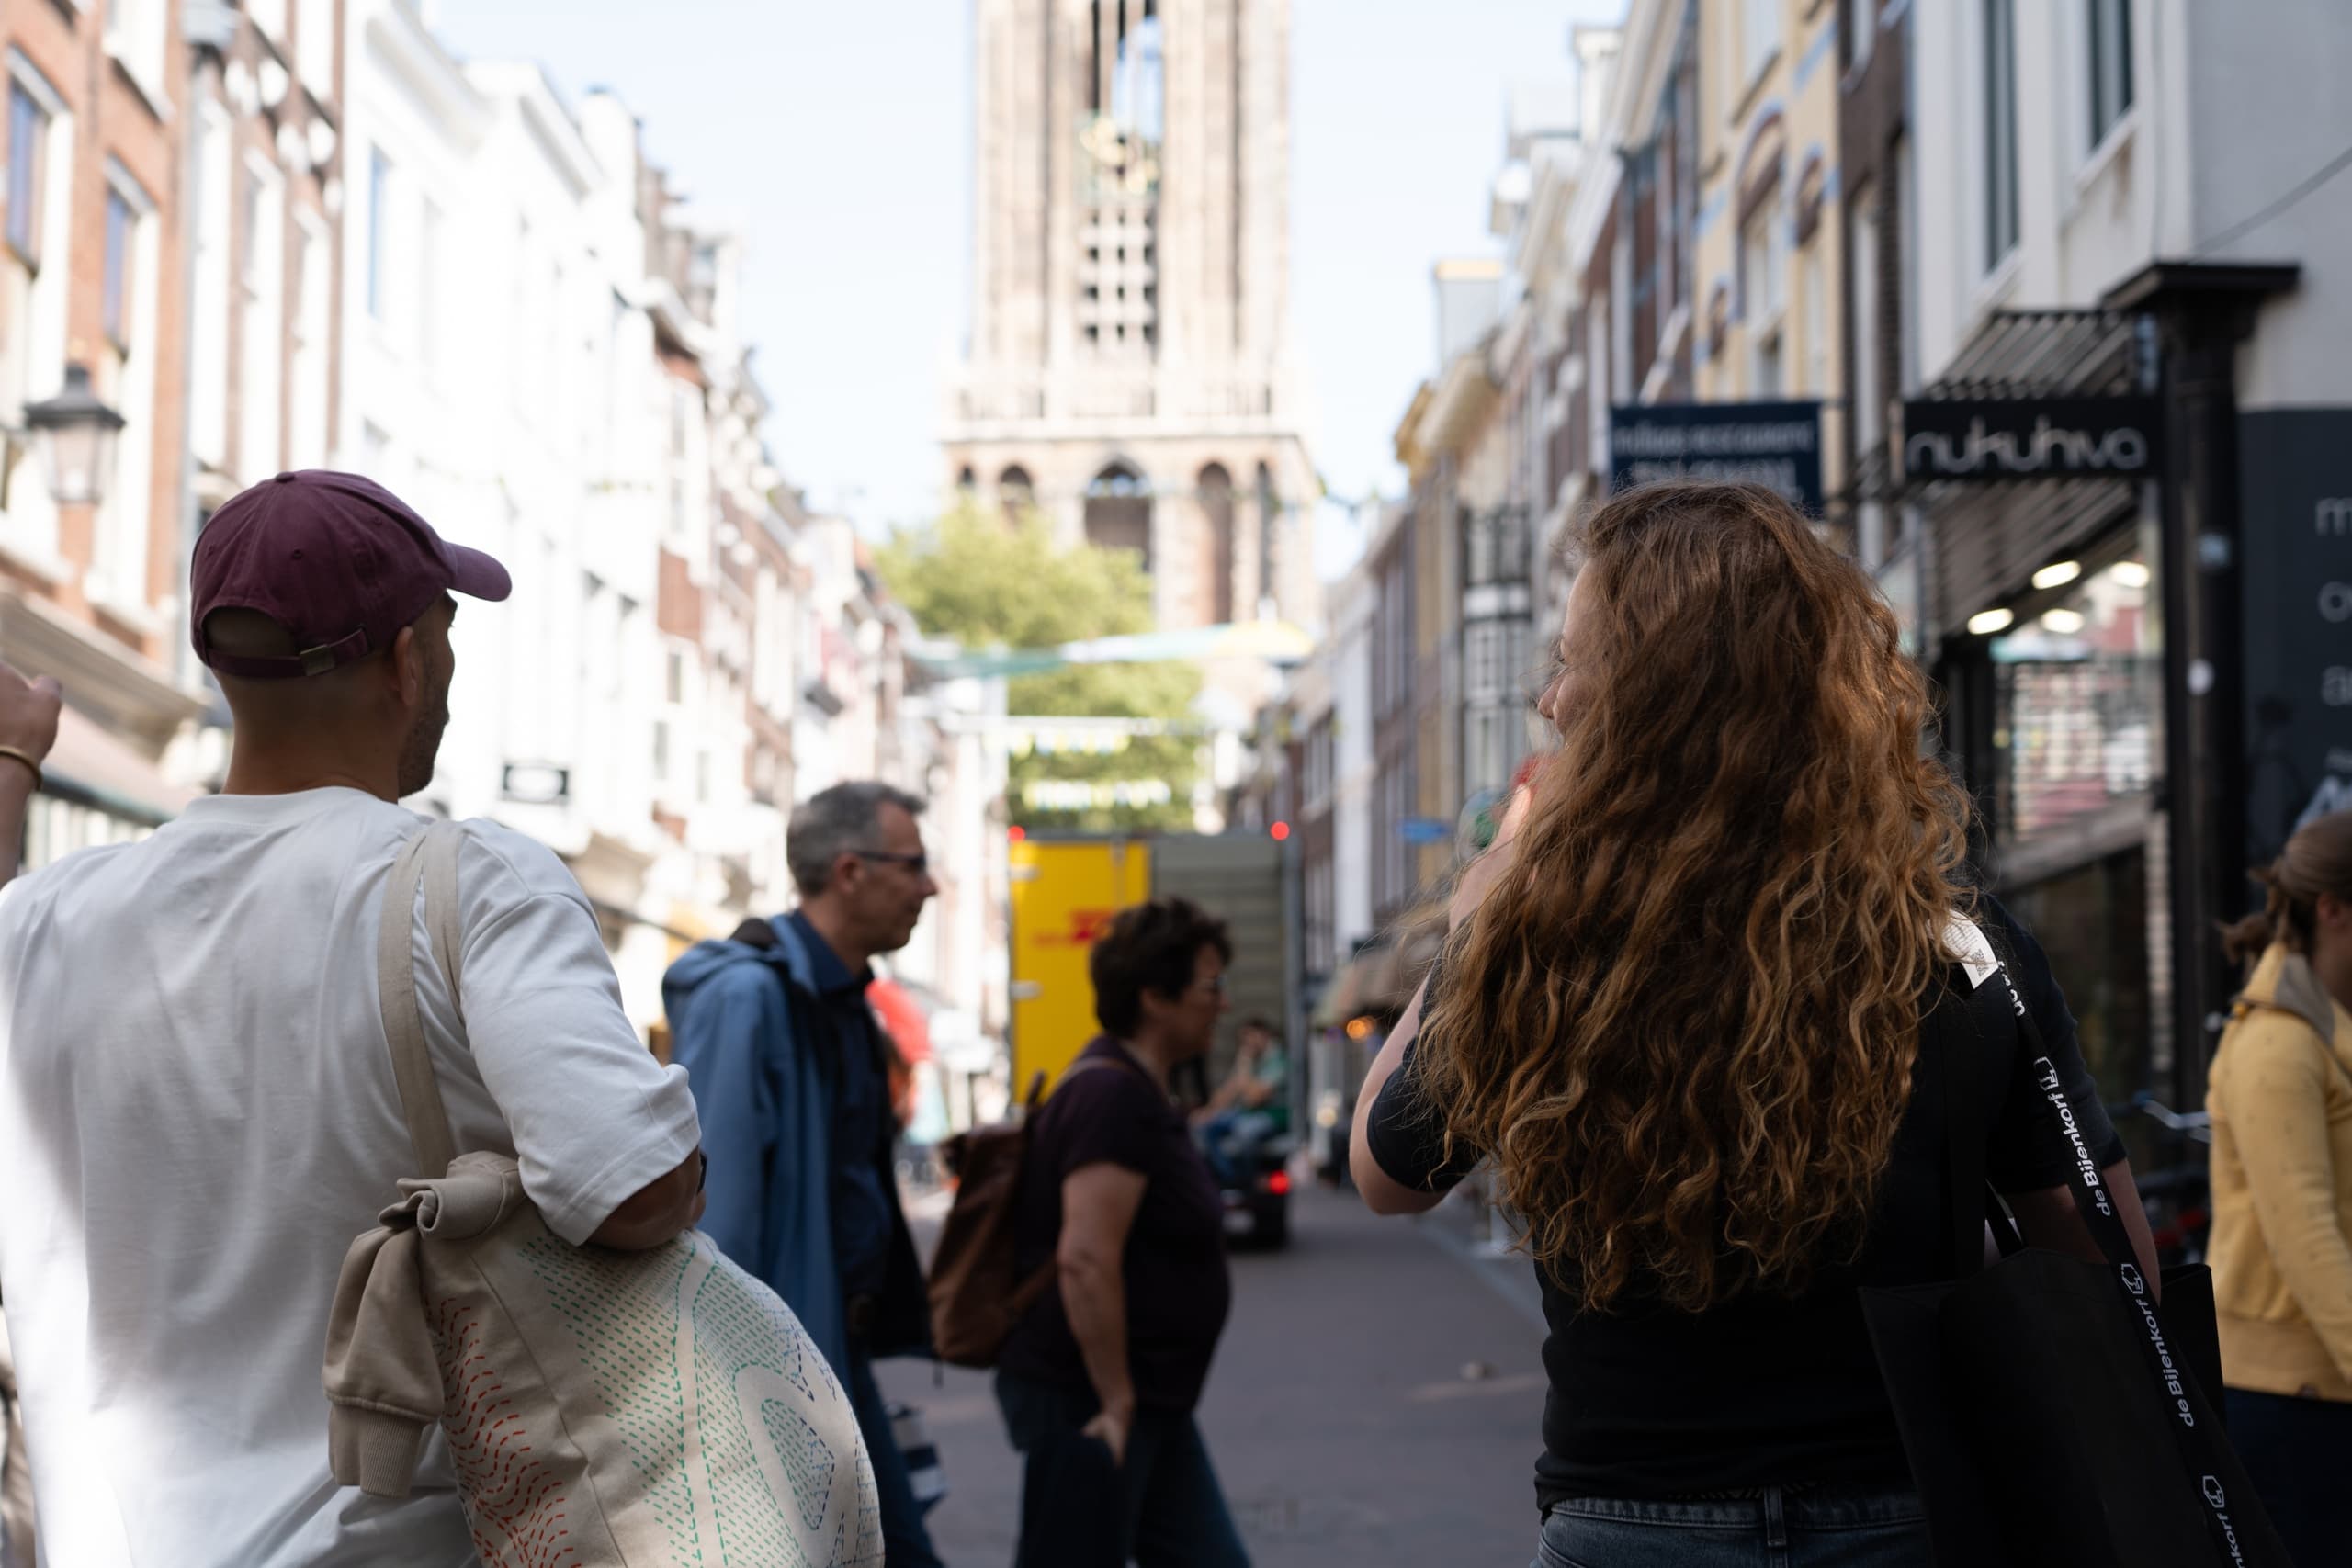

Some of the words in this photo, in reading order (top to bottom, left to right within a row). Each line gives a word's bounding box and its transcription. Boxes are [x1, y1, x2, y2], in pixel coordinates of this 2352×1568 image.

[2047, 1092, 2100, 1187] Bijenkorf
[2095, 1189, 2111, 1216] de
[2135, 1298, 2184, 1395] Bijenkorf
[2177, 1398, 2195, 1427] de
